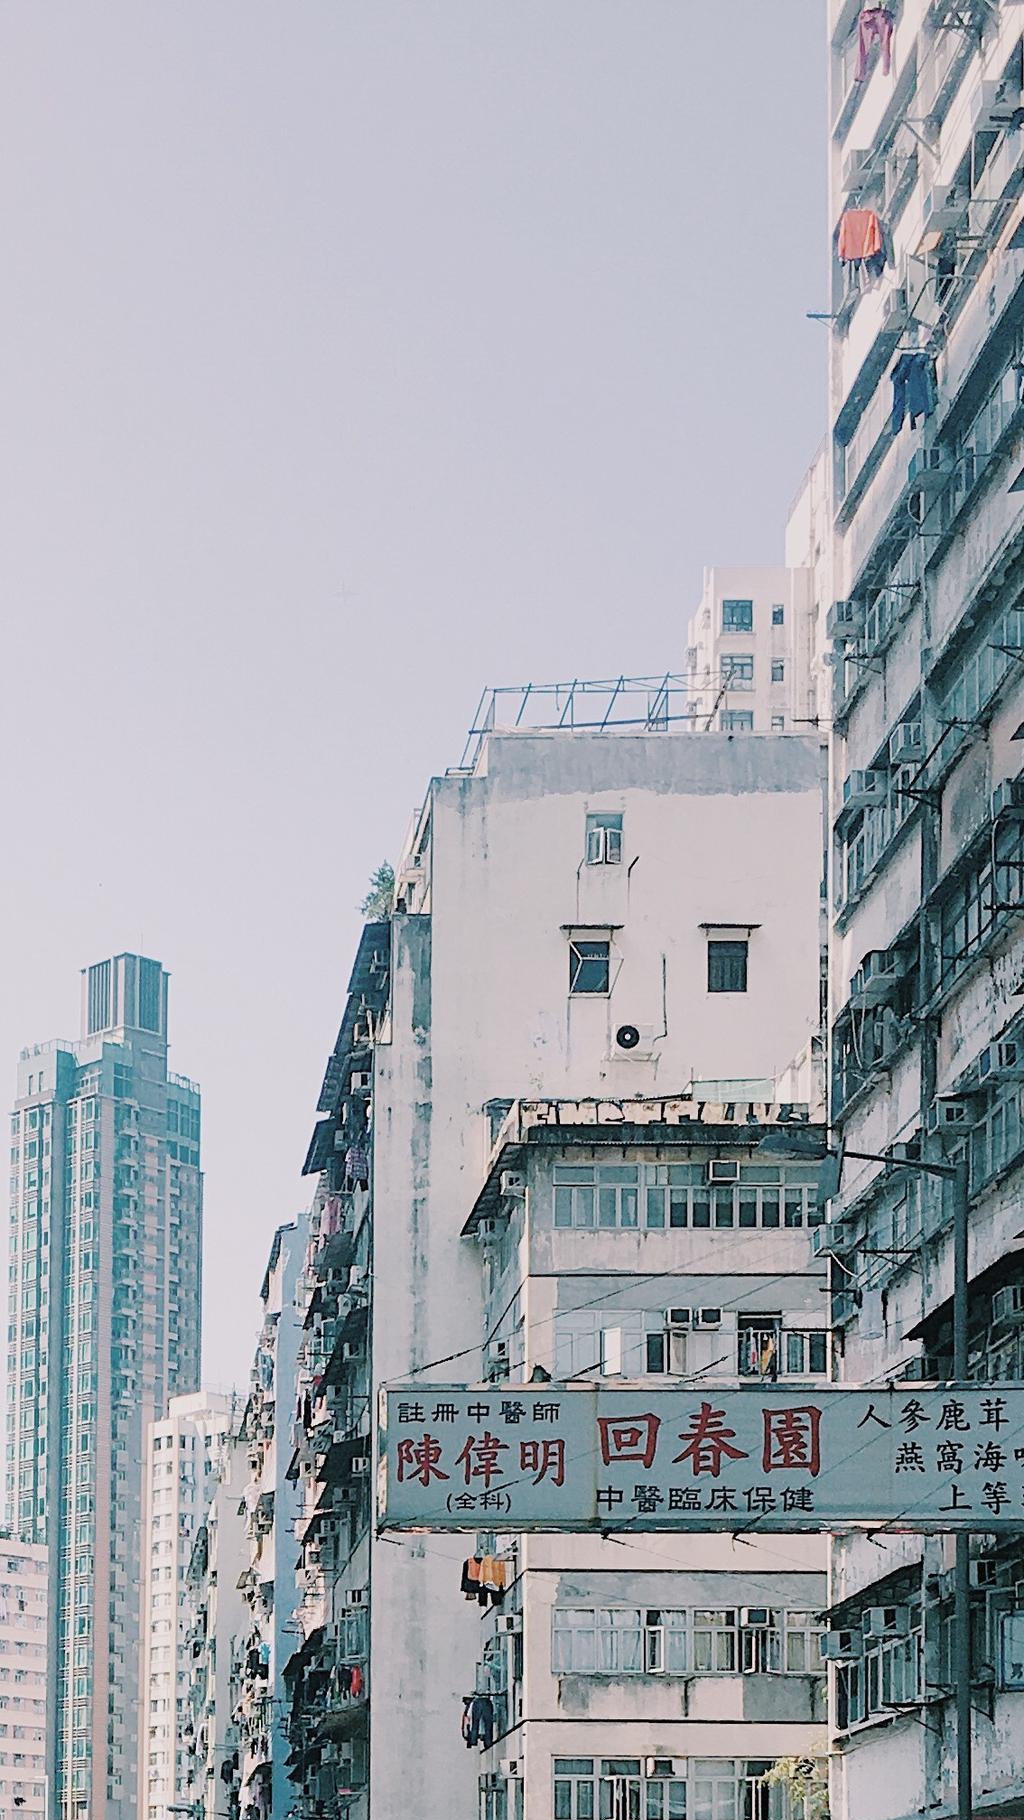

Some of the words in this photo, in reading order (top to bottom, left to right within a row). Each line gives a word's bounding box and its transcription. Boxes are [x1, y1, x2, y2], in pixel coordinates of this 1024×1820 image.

[397, 1401, 561, 1423] 註冊中醫師
[857, 1398, 1010, 1433] 人參鹿茸
[597, 1402, 822, 1478] 回春園
[397, 1431, 566, 1488] 陳偉明
[446, 1492, 512, 1513] (全科)
[596, 1485, 814, 1513] 中醫臨床保健
[939, 1481, 1024, 1515] 上等
